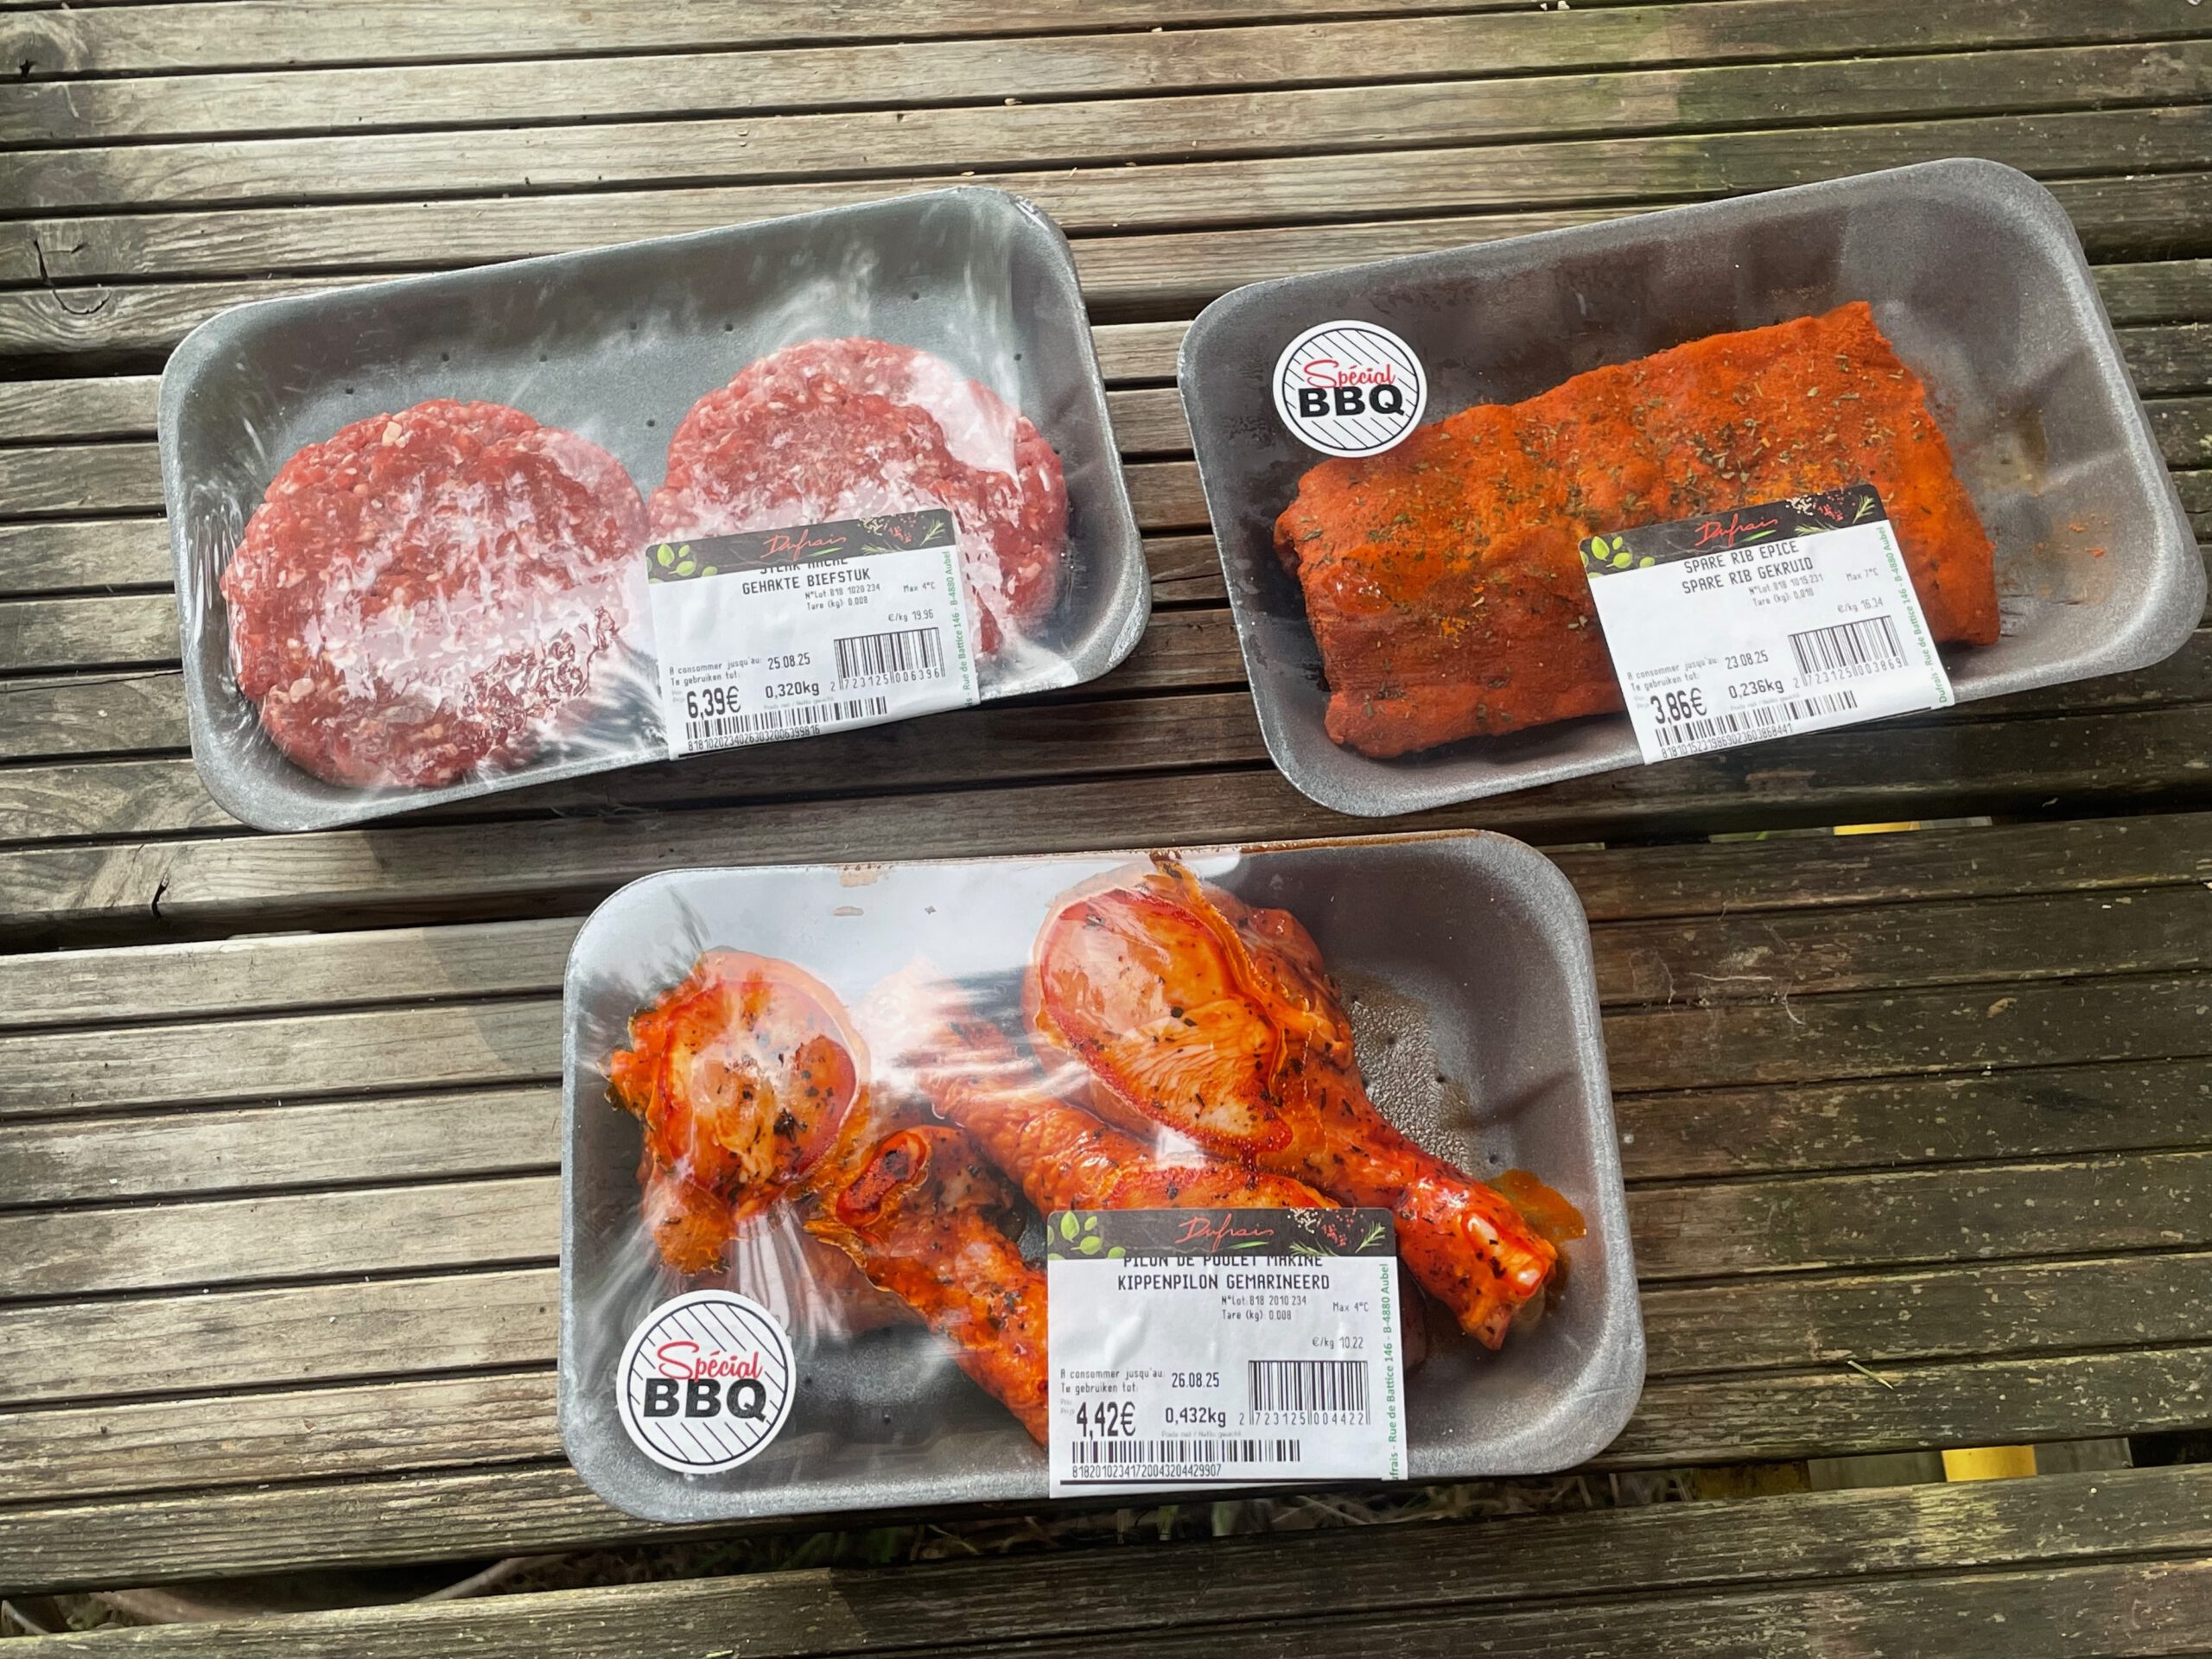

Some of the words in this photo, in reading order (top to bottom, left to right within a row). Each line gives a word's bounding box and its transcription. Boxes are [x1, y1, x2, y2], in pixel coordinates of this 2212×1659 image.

[1304, 359, 1395, 388] Spécial
[1298, 384, 1405, 418] BBQ
[1694, 512, 1778, 547] Dufrais
[1876, 526, 1891, 550] Aubel
[760, 529, 847, 561] Dufrais
[942, 551, 954, 575] Aubel
[1683, 554, 1726, 574] SPARE
[1731, 549, 1755, 565] RIB
[1759, 540, 1800, 559] EPICE
[1885, 552, 1903, 582] B-4880
[742, 576, 800, 594] GEHAKTE
[807, 568, 871, 587] BIEFSTUK
[1681, 574, 1725, 594] SPARE
[1729, 569, 1752, 585] RIB
[1758, 556, 1815, 580] GEKRUID
[1846, 573, 1861, 582] Max
[903, 584, 918, 593] Max
[946, 576, 958, 606] B-4880
[1898, 588, 1910, 604] 146
[807, 601, 823, 611] Tare
[1752, 598, 1770, 607] Tare
[1860, 596, 1883, 610] 16.34
[888, 613, 908, 622] €/kg
[912, 609, 934, 620] 19.96
[1906, 606, 1923, 636] Battice
[954, 630, 966, 659] Battice
[1916, 637, 1927, 648] de
[958, 661, 969, 671] de
[1923, 650, 1934, 666] Rue
[678, 663, 722, 674] consommer
[1636, 664, 1680, 679] consommer
[671, 677, 680, 686] Te
[683, 674, 722, 686] gebruiken
[766, 680, 820, 699] 0,320kg
[830, 682, 836, 692] 2
[1630, 683, 1641, 691] Te
[1643, 676, 1681, 691] gebruiken
[1728, 678, 1785, 699] 0,236kg
[1793, 677, 1801, 689] 2
[1931, 672, 1947, 703] Dufrais
[686, 686, 741, 720] 6,39€
[1650, 687, 1707, 725] 3,86€
[1175, 1213, 1274, 1252] Dufrais
[1118, 1274, 1218, 1290] KIPPENPILON
[1226, 1274, 1330, 1289] GEMARINEERD
[1379, 1263, 1390, 1294] Aubel
[1222, 1309, 1242, 1319] Tare
[1332, 1302, 1350, 1312] Max
[1381, 1296, 1392, 1333] B-4880
[1312, 1337, 1335, 1349] €/kg
[1338, 1337, 1363, 1349] 10.22
[1383, 1343, 1393, 1363] 146
[657, 1341, 763, 1382] Spécial
[1060, 1369, 1065, 1379] A
[1070, 1370, 1120, 1378] consommer
[1172, 1371, 1220, 1388] 26.08.25
[1385, 1365, 1395, 1402] Battice
[1061, 1383, 1071, 1393] Te
[1075, 1383, 1118, 1395] gebruiken
[643, 1377, 767, 1423] BBQ
[1077, 1401, 1135, 1440] 4,42€
[1166, 1407, 1226, 1427] 0,432kg
[1239, 1413, 1245, 1426] 2
[1387, 1406, 1396, 1419] de
[1389, 1422, 1397, 1442] Rue
